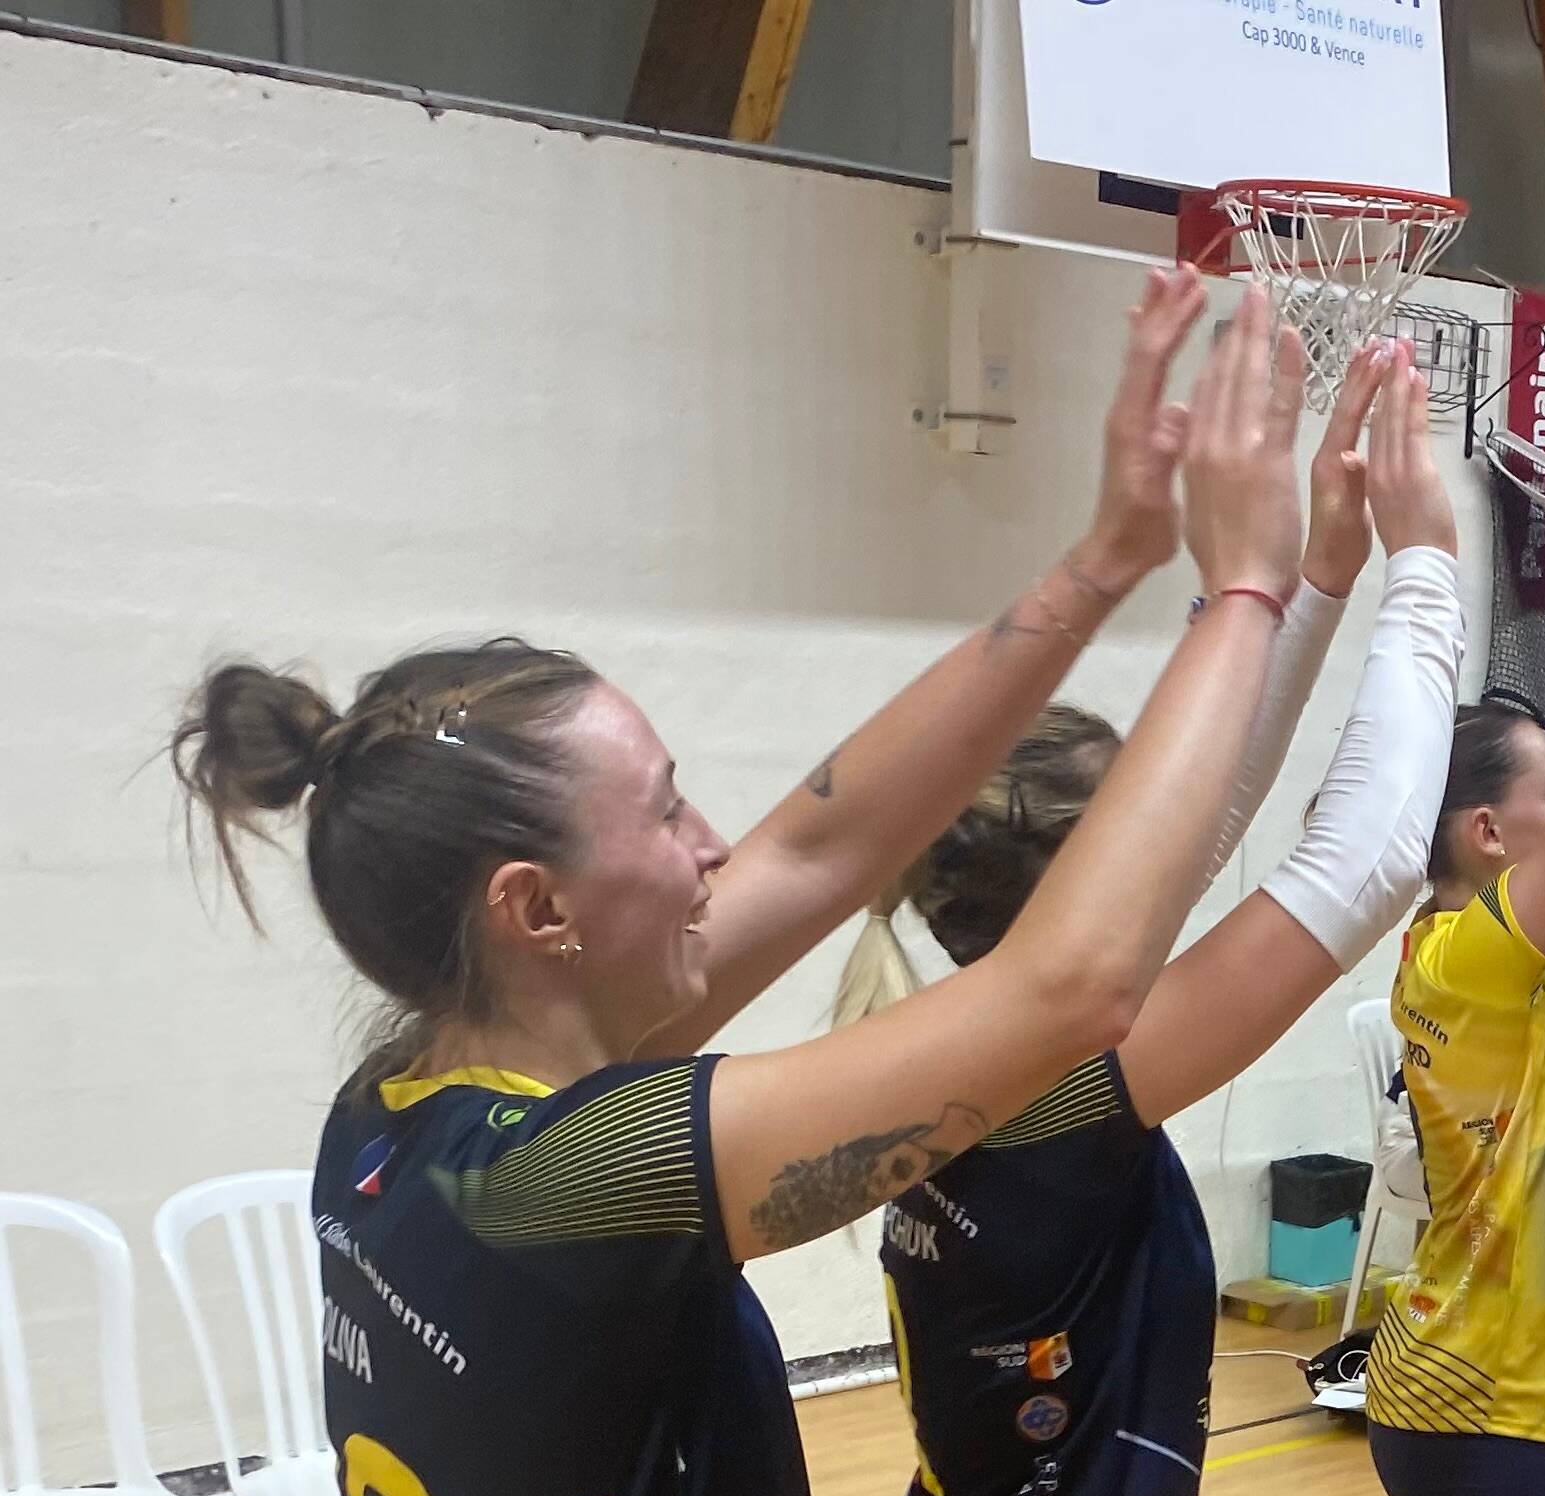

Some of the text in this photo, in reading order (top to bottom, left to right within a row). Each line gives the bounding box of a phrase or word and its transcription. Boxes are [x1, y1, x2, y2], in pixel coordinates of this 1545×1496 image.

[1242, 20, 1365, 66] Cap 3000 & Vence
[1296, 1, 1343, 30] Santé
[1349, 17, 1424, 49] naturelle
[884, 1200, 941, 1262] CHUK
